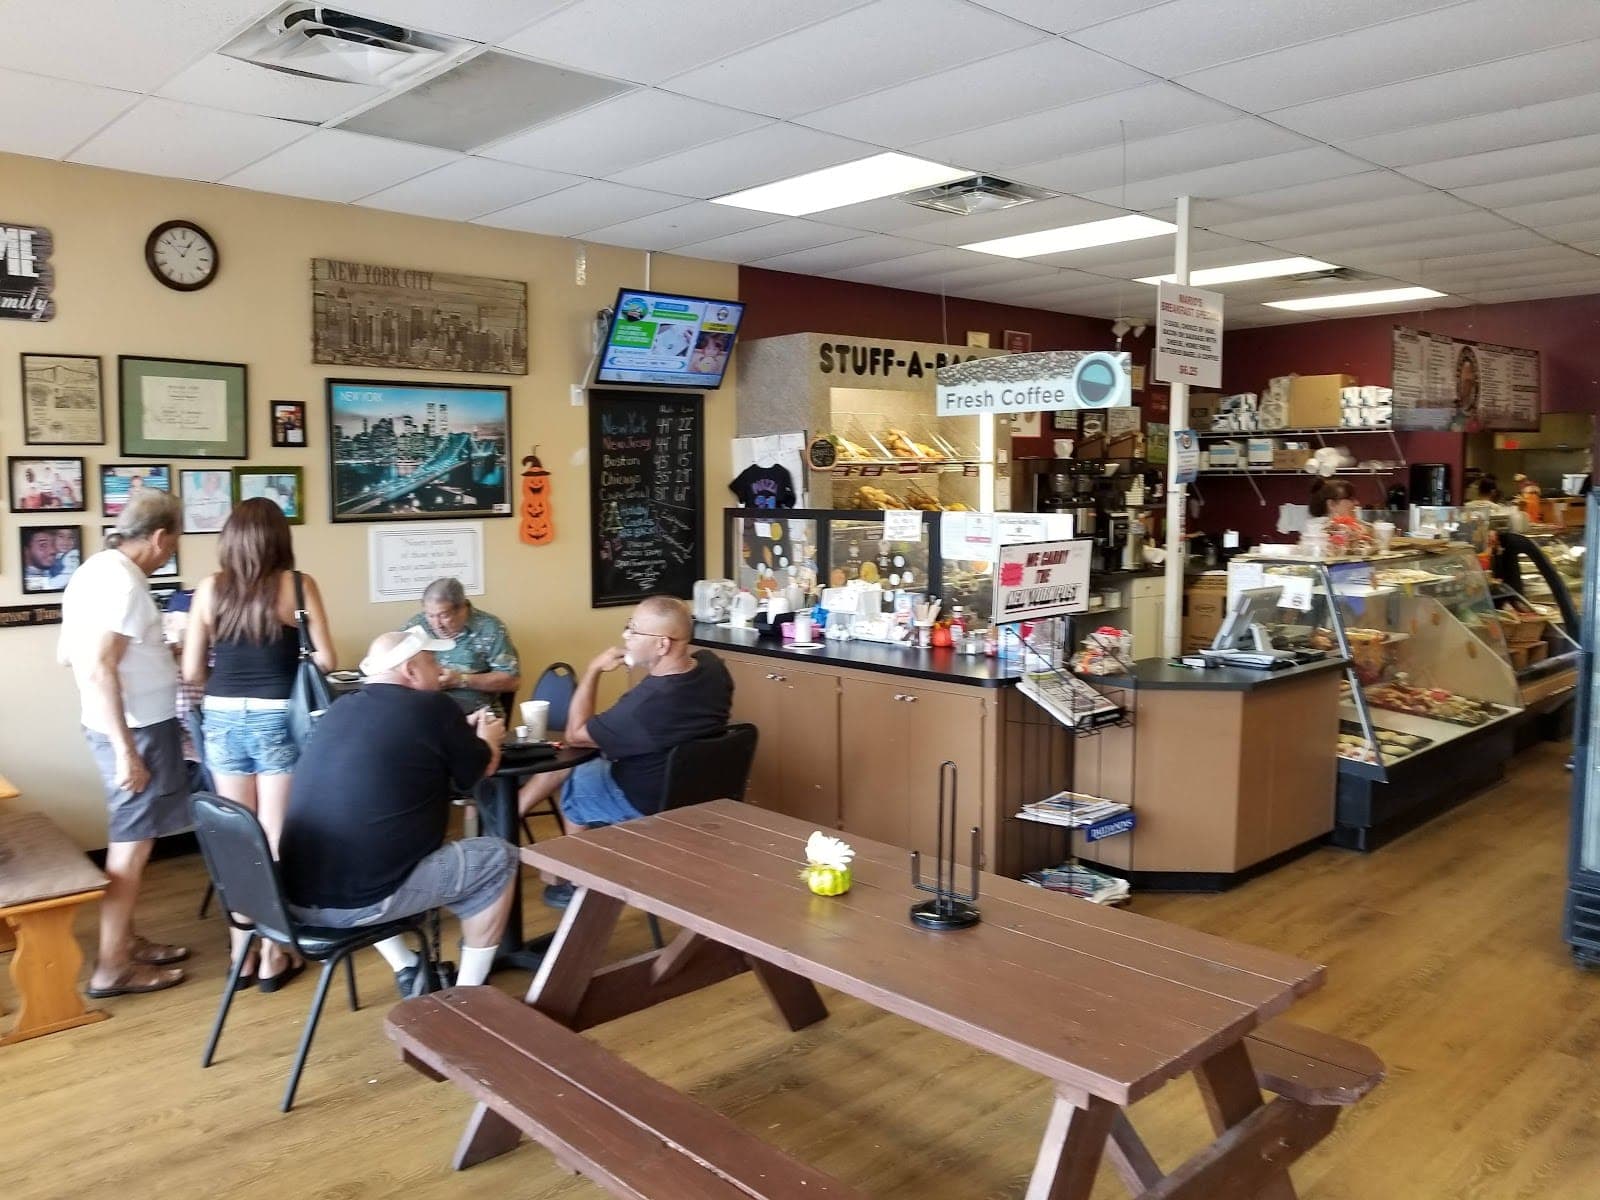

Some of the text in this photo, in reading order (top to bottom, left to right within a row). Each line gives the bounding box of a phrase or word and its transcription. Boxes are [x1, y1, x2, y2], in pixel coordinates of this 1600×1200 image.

[328, 260, 433, 290] NEW YORK CITY
[1160, 301, 1194, 317] BREAKFAST
[819, 343, 977, 378] STUFF-A-B
[339, 391, 384, 402] NEW YORK
[946, 386, 1065, 409] Fresh Coffee
[602, 454, 640, 468] Boston
[601, 471, 641, 490] Chicago
[1026, 550, 1070, 567] WE CARRY
[1035, 570, 1051, 584] THE
[1058, 583, 1081, 601] POST
